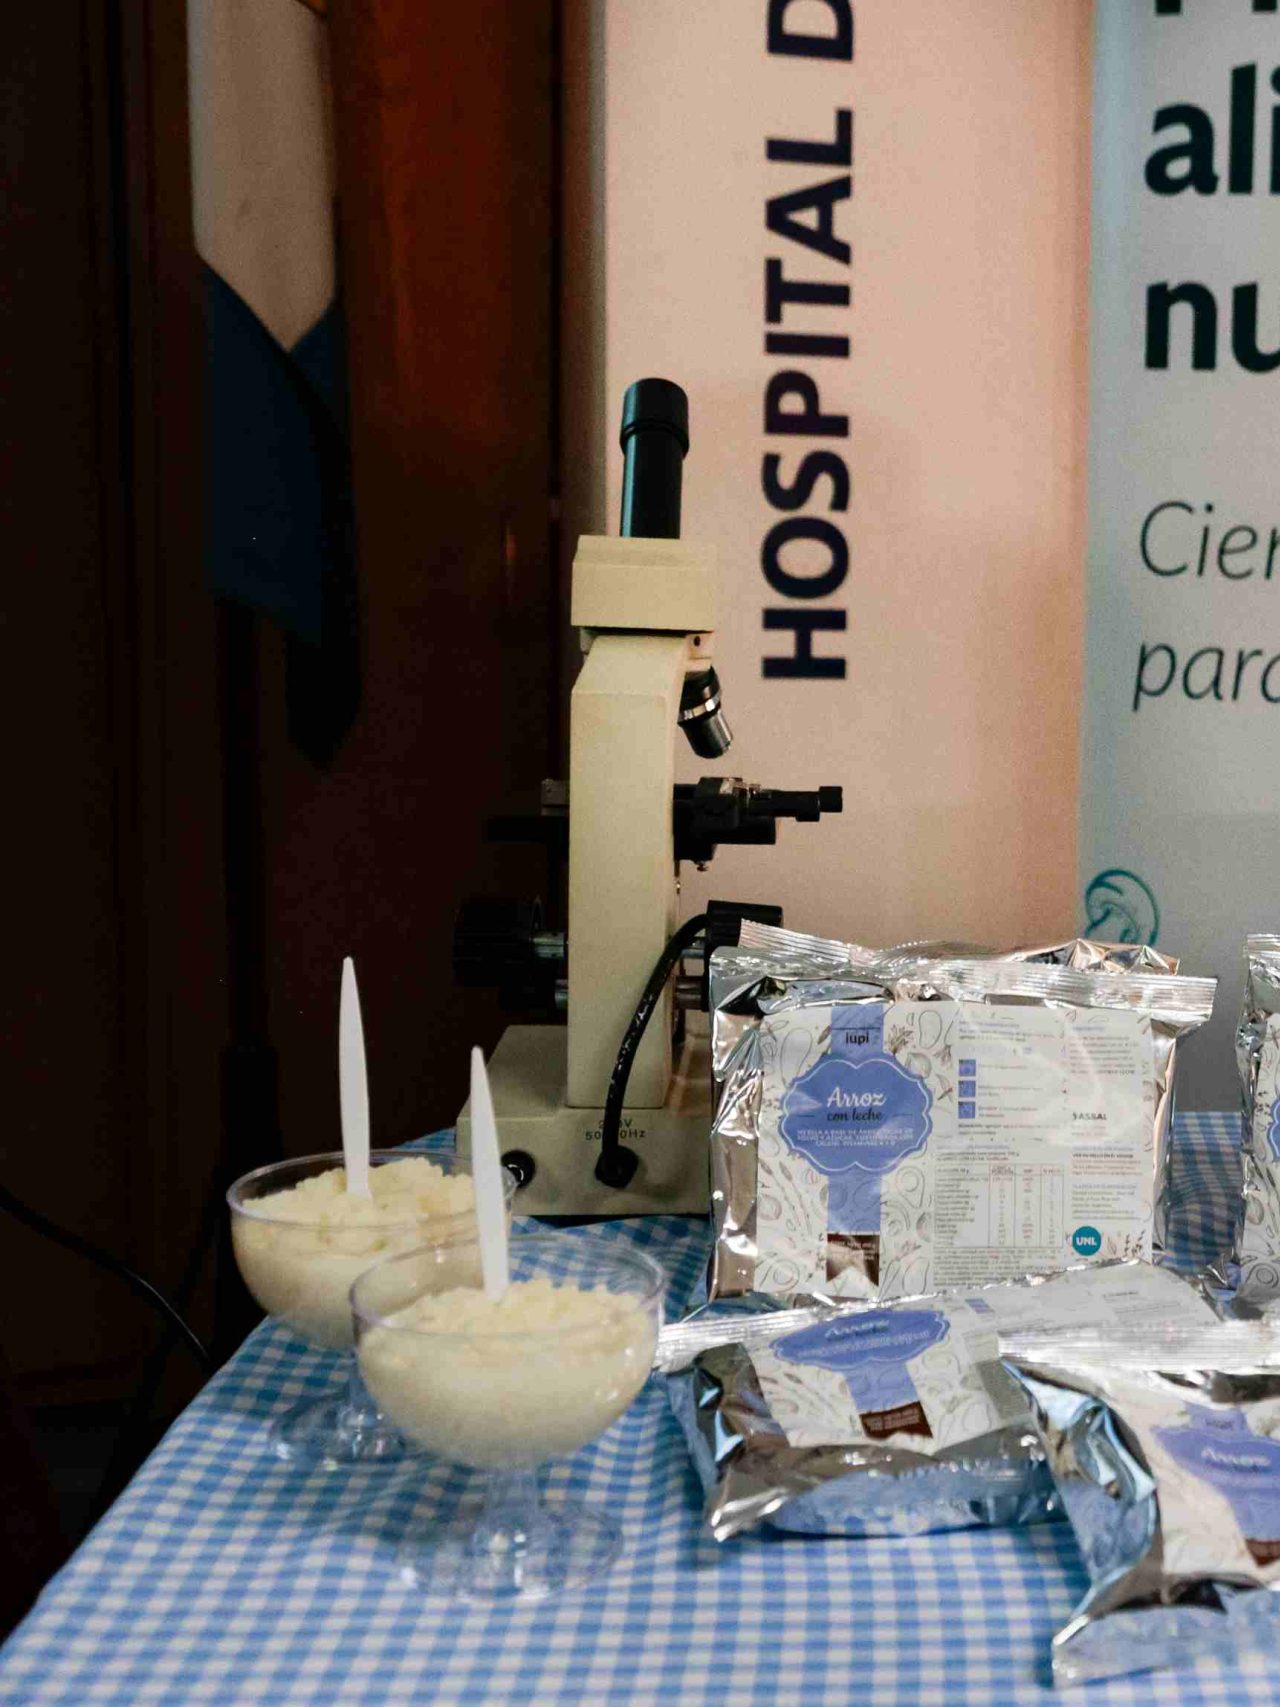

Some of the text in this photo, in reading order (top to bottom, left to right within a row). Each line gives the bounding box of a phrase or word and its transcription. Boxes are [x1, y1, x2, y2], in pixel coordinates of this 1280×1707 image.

[760, 109, 853, 680] HOSPITAL
[826, 1086, 888, 1108] Arroz
[826, 1107, 883, 1122] con leche
[1075, 1236, 1098, 1247] UNL
